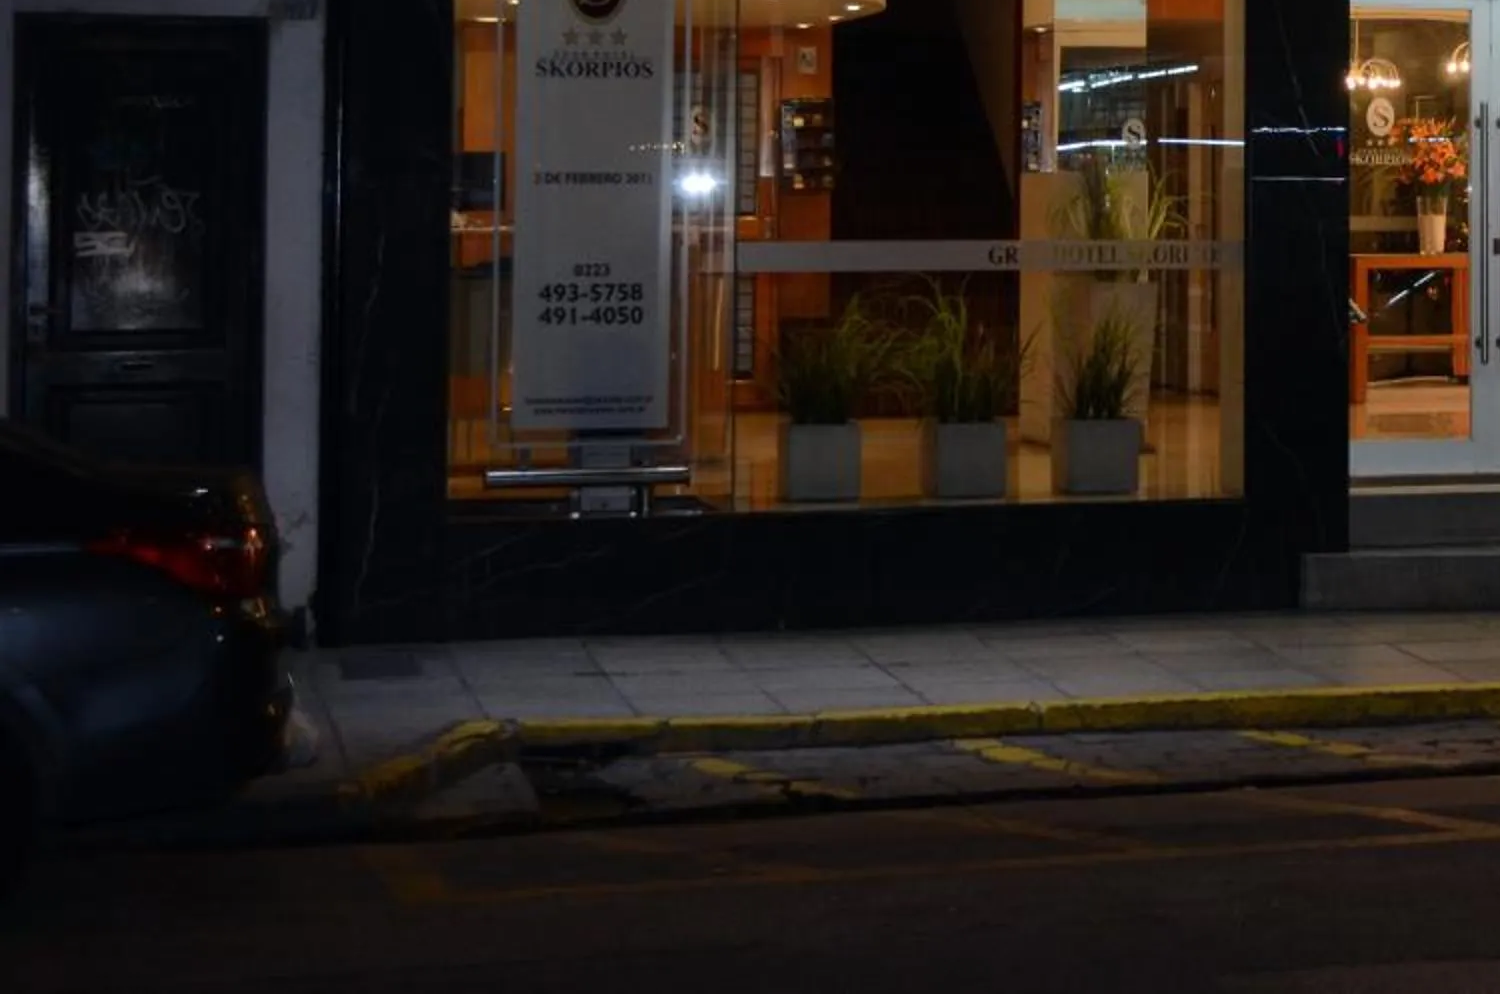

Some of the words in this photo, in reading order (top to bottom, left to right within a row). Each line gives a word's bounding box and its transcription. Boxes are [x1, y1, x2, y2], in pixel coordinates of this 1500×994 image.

[535, 58, 653, 78] SKORPIOS
[538, 284, 643, 303] 493-5758
[538, 306, 643, 325] 491-4050
